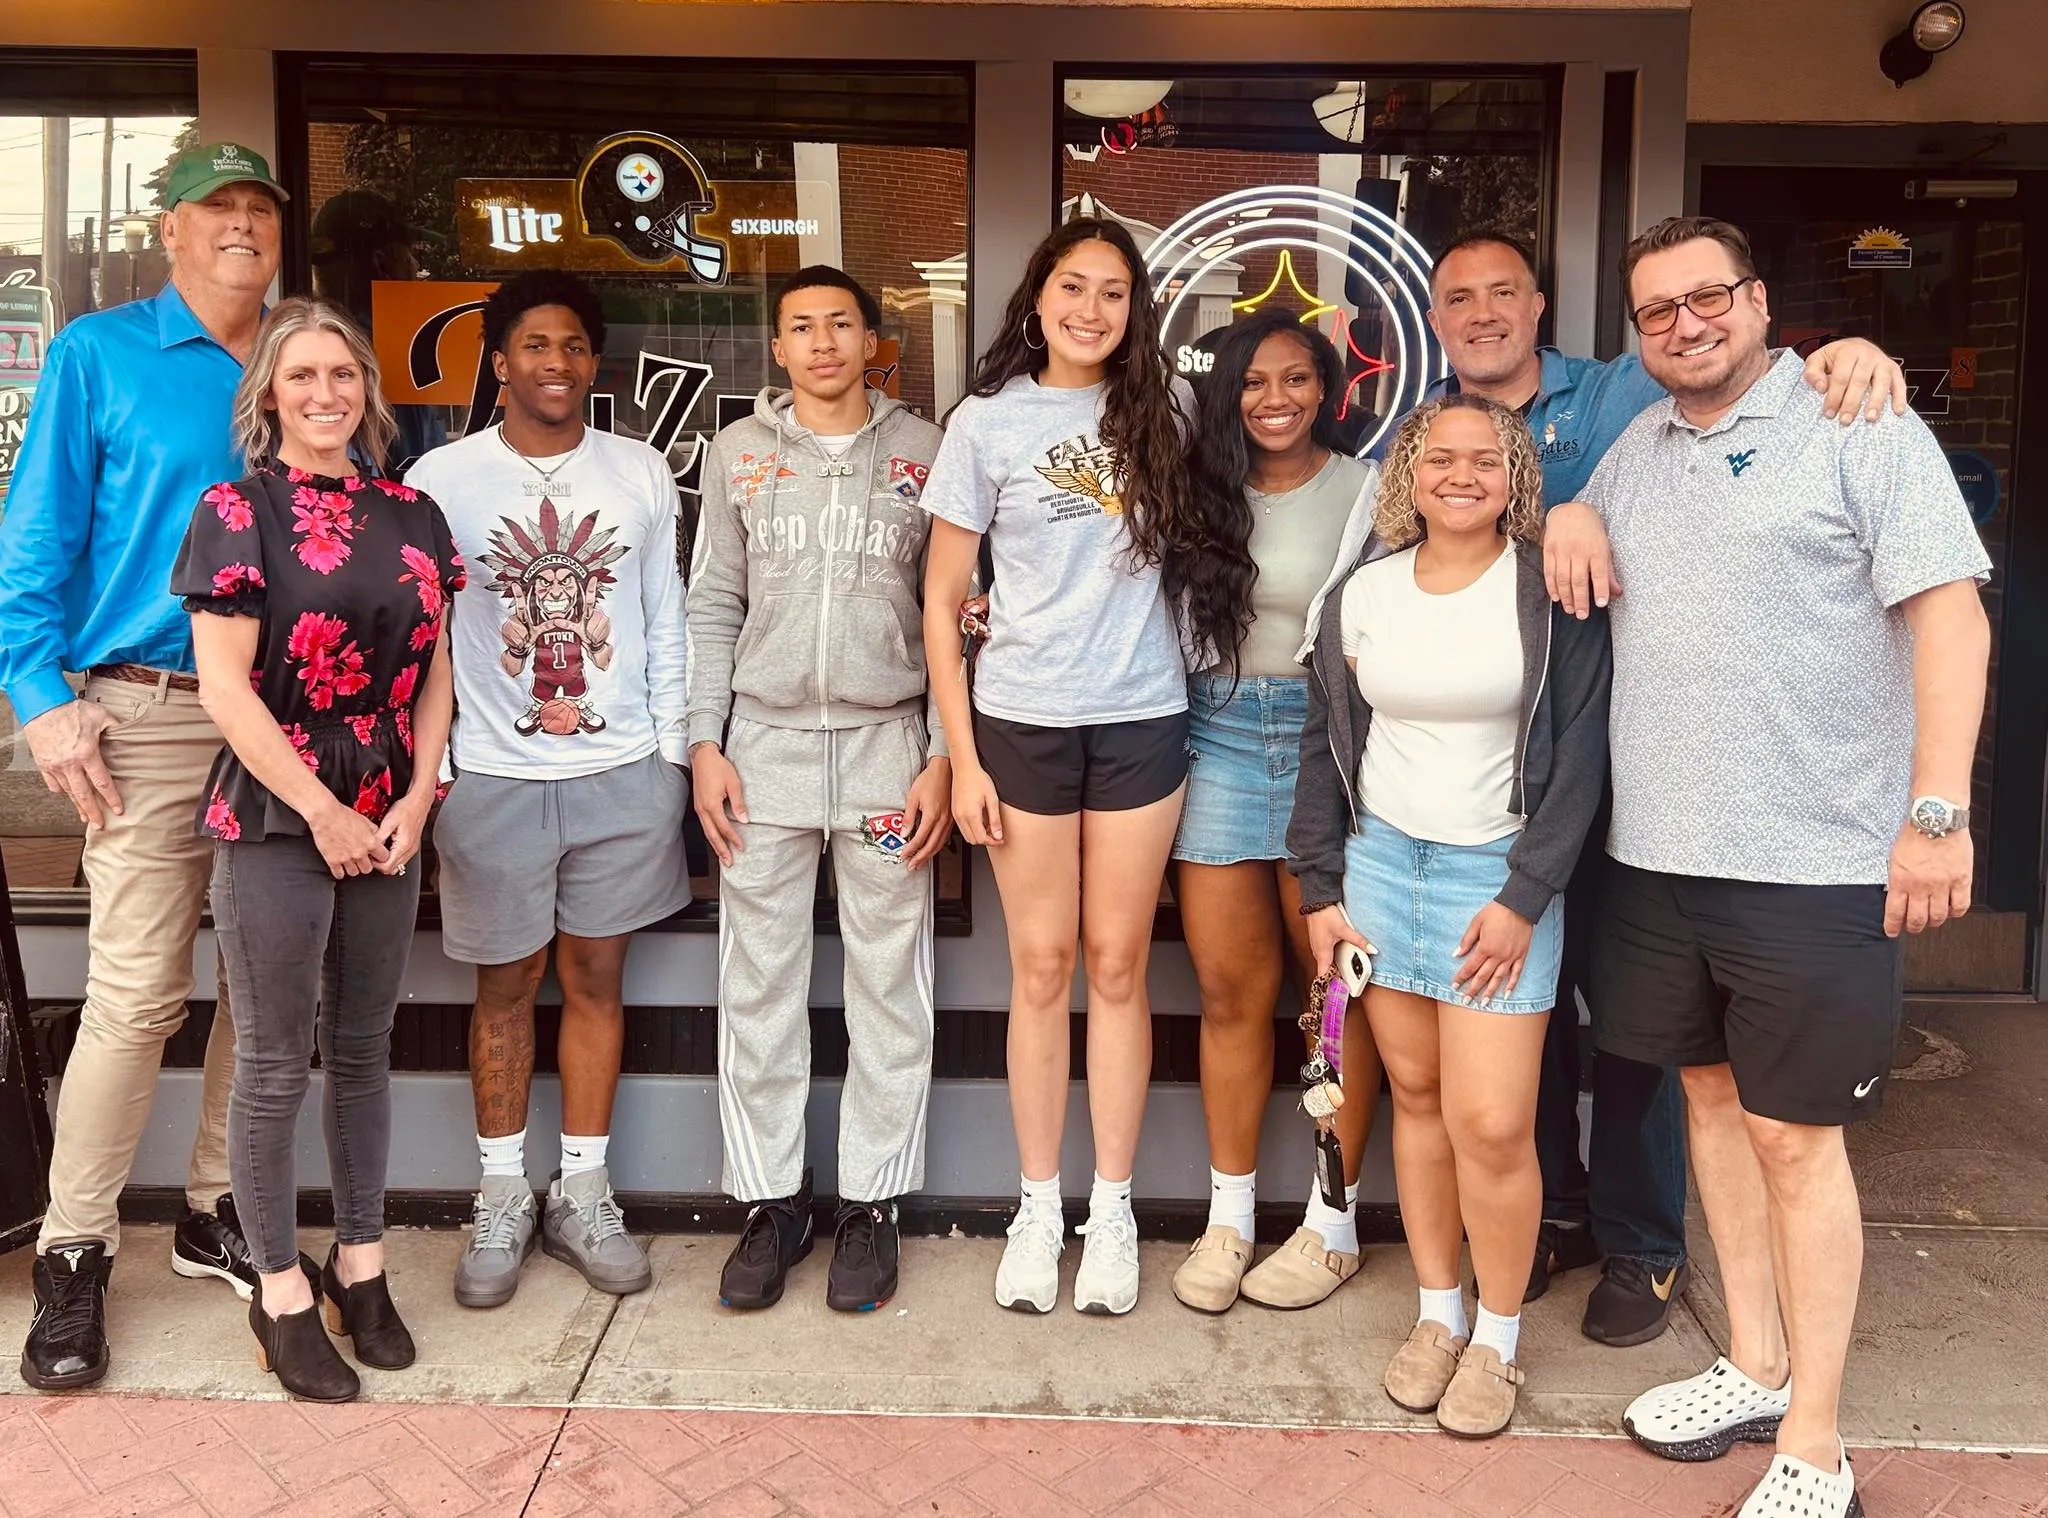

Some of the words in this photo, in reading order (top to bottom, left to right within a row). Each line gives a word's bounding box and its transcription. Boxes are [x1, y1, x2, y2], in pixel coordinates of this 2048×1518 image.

[487, 205, 563, 253] Lite
[731, 218, 819, 235] SIXBURGH
[742, 508, 807, 561] Keep
[523, 555, 587, 582] UNIONTOWN
[552, 642, 567, 669] 1
